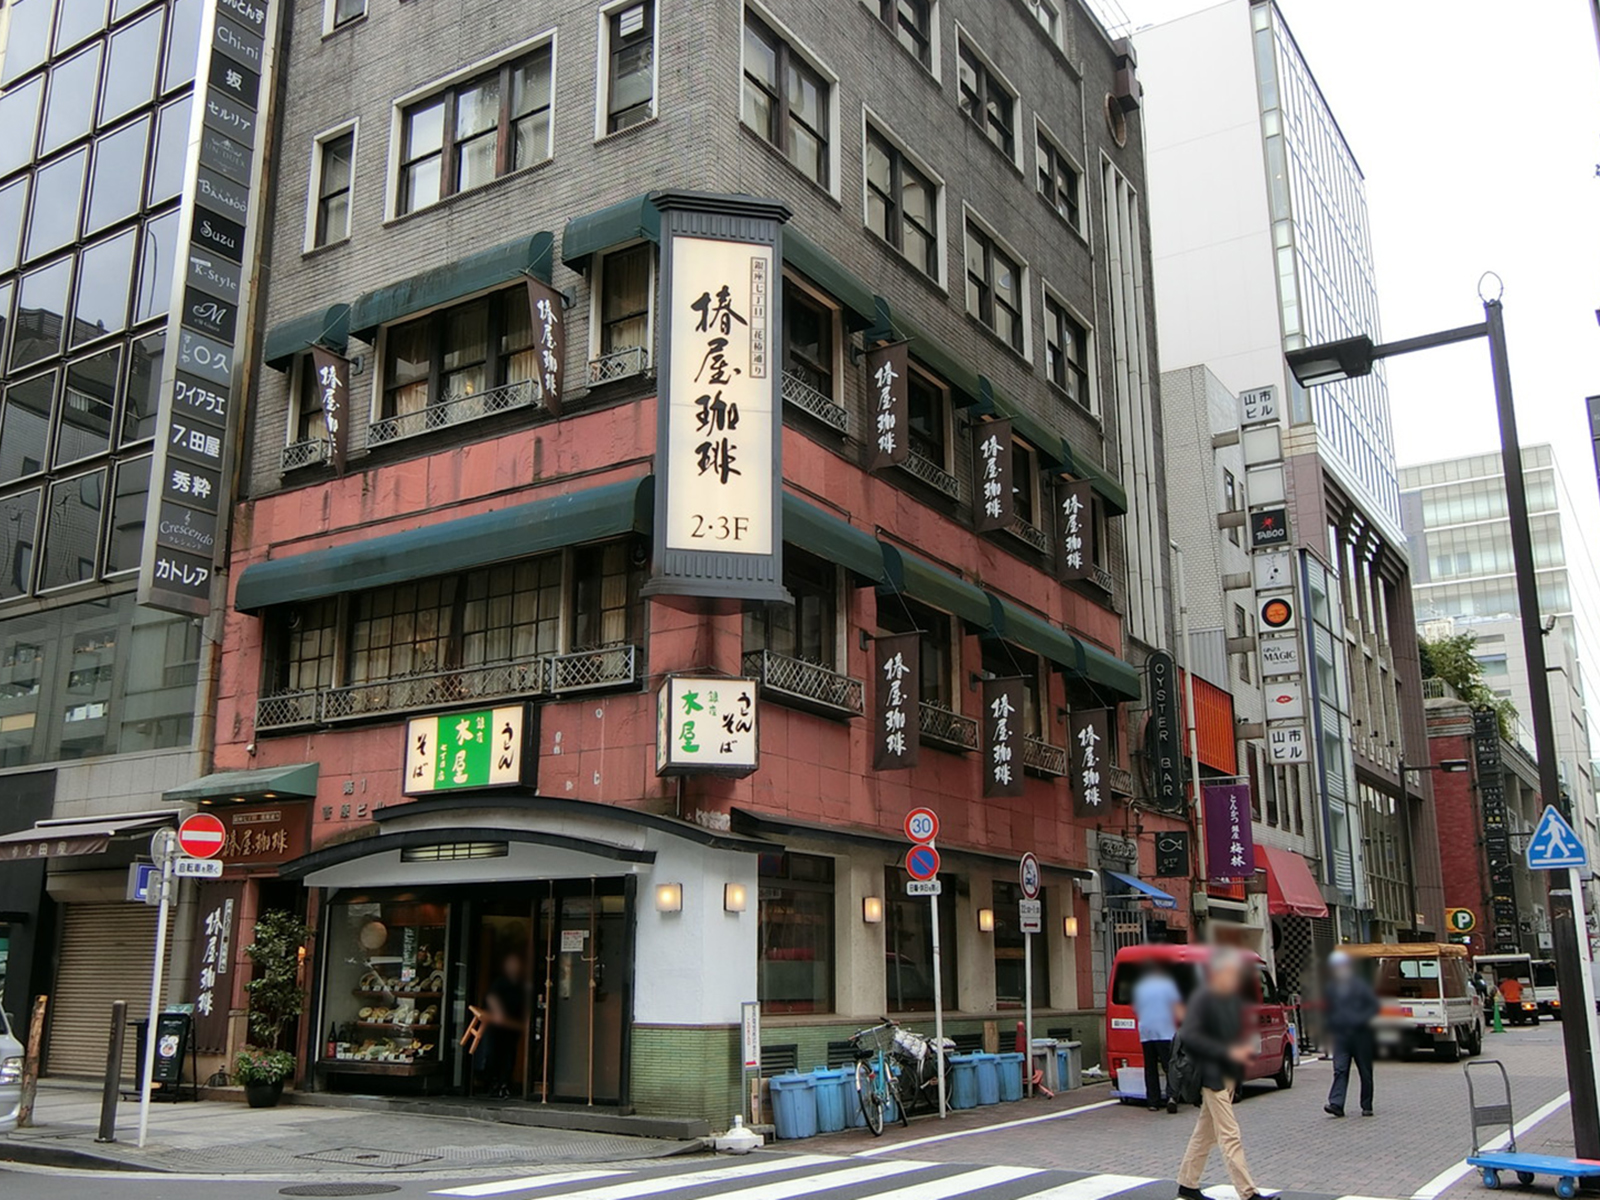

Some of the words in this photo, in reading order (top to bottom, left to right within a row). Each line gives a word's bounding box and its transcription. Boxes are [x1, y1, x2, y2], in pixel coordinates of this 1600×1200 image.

[217, 26, 259, 60] Chi-ni
[225, 68, 243, 91] 坂
[207, 101, 251, 132] セルリア
[176, 382, 225, 416] ワイアラエ
[691, 285, 748, 485] 椿屋珈琲
[1244, 390, 1271, 406] 山市
[874, 360, 899, 455] 椿屋珈琲
[1246, 405, 1273, 419] ビル
[980, 434, 1004, 519] 椿屋珈琲
[160, 520, 214, 546] Crescendo
[1062, 493, 1085, 569] 椿屋珈琲
[1255, 528, 1285, 541] TABOO
[156, 557, 209, 586] カトレア
[1264, 650, 1296, 661] MAGIC
[883, 652, 911, 757] 椿屋珈琲
[1154, 663, 1169, 742] OYSTER
[679, 689, 704, 753] 木屋
[720, 712, 738, 754] そば
[1272, 729, 1301, 744] 山市
[412, 733, 429, 779] そば
[452, 718, 474, 784] 木屋
[991, 693, 1016, 786] 椿屋珈琲
[1273, 745, 1303, 759] ビル
[1078, 723, 1102, 807] 椿屋珈琲
[1160, 757, 1173, 797] BAR
[912, 818, 931, 834] 30
[179, 863, 219, 874] 自転車を除く
[1229, 841, 1246, 868] 梅林
[1457, 912, 1471, 928] P
[197, 906, 223, 1016] 椿屋珈琲
